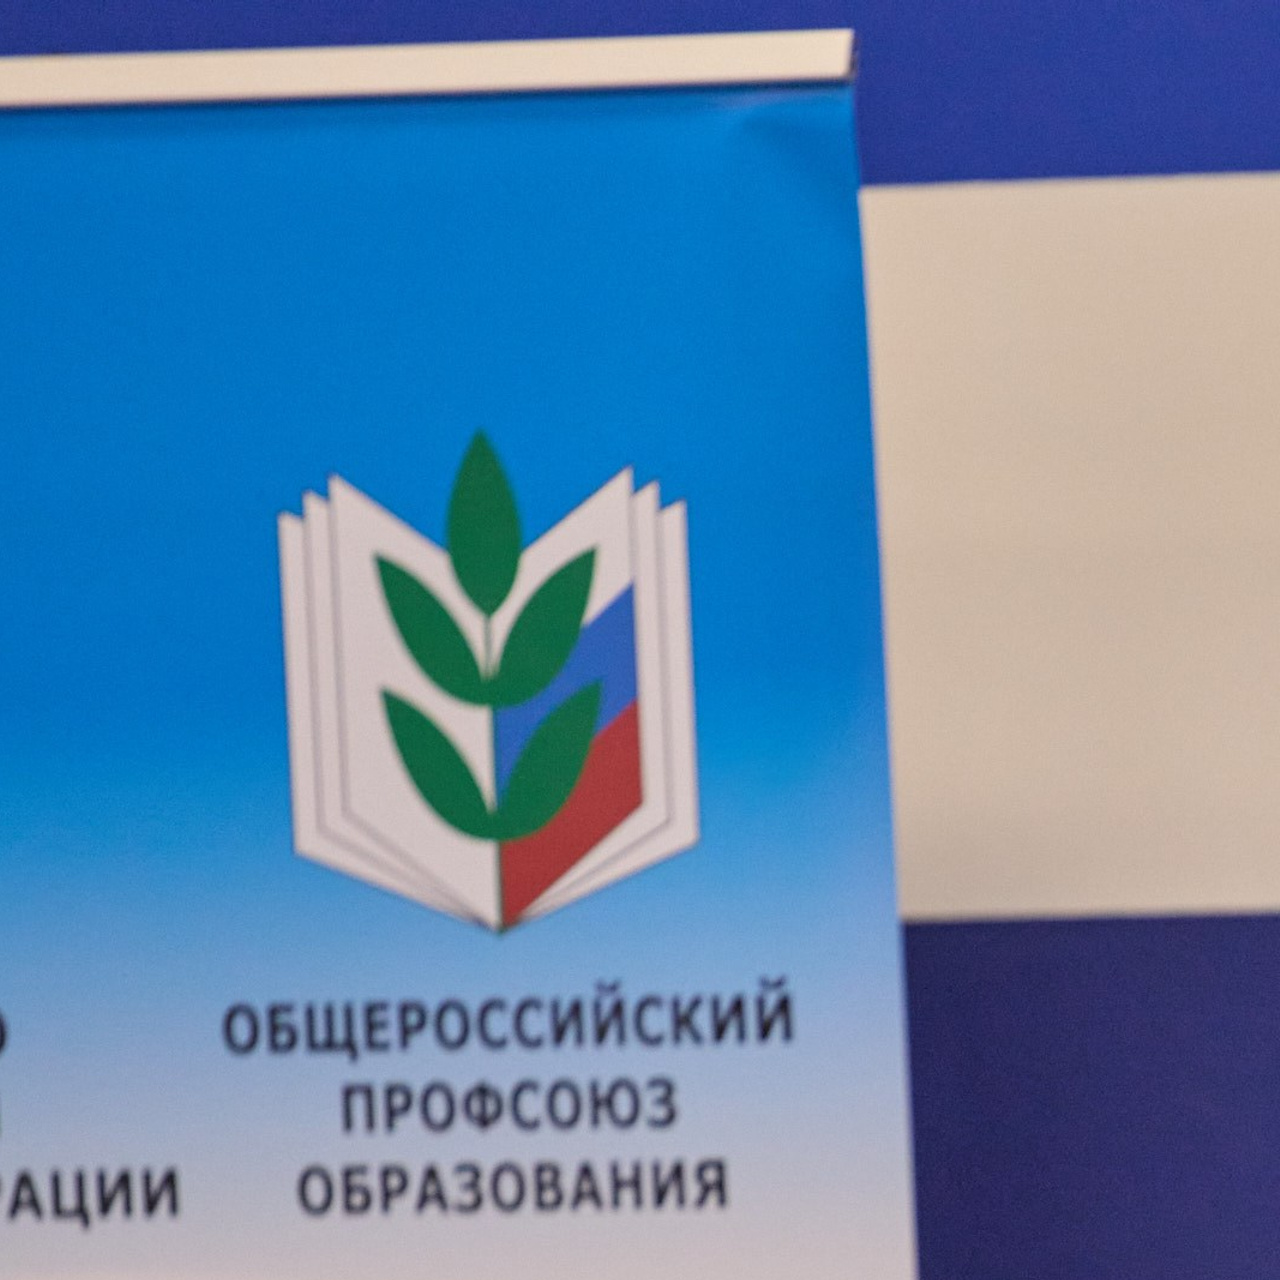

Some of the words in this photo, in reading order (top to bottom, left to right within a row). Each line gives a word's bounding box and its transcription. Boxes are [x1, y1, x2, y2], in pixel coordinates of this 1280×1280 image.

[221, 977, 793, 1062] ОБЩЕРОССИЙСКИЙ
[341, 1077, 677, 1133] ПРОФСОЮЗ
[0, 1165, 181, 1229] АЦИИ
[296, 1157, 729, 1217] ОБРАЗОВАНИЯ
